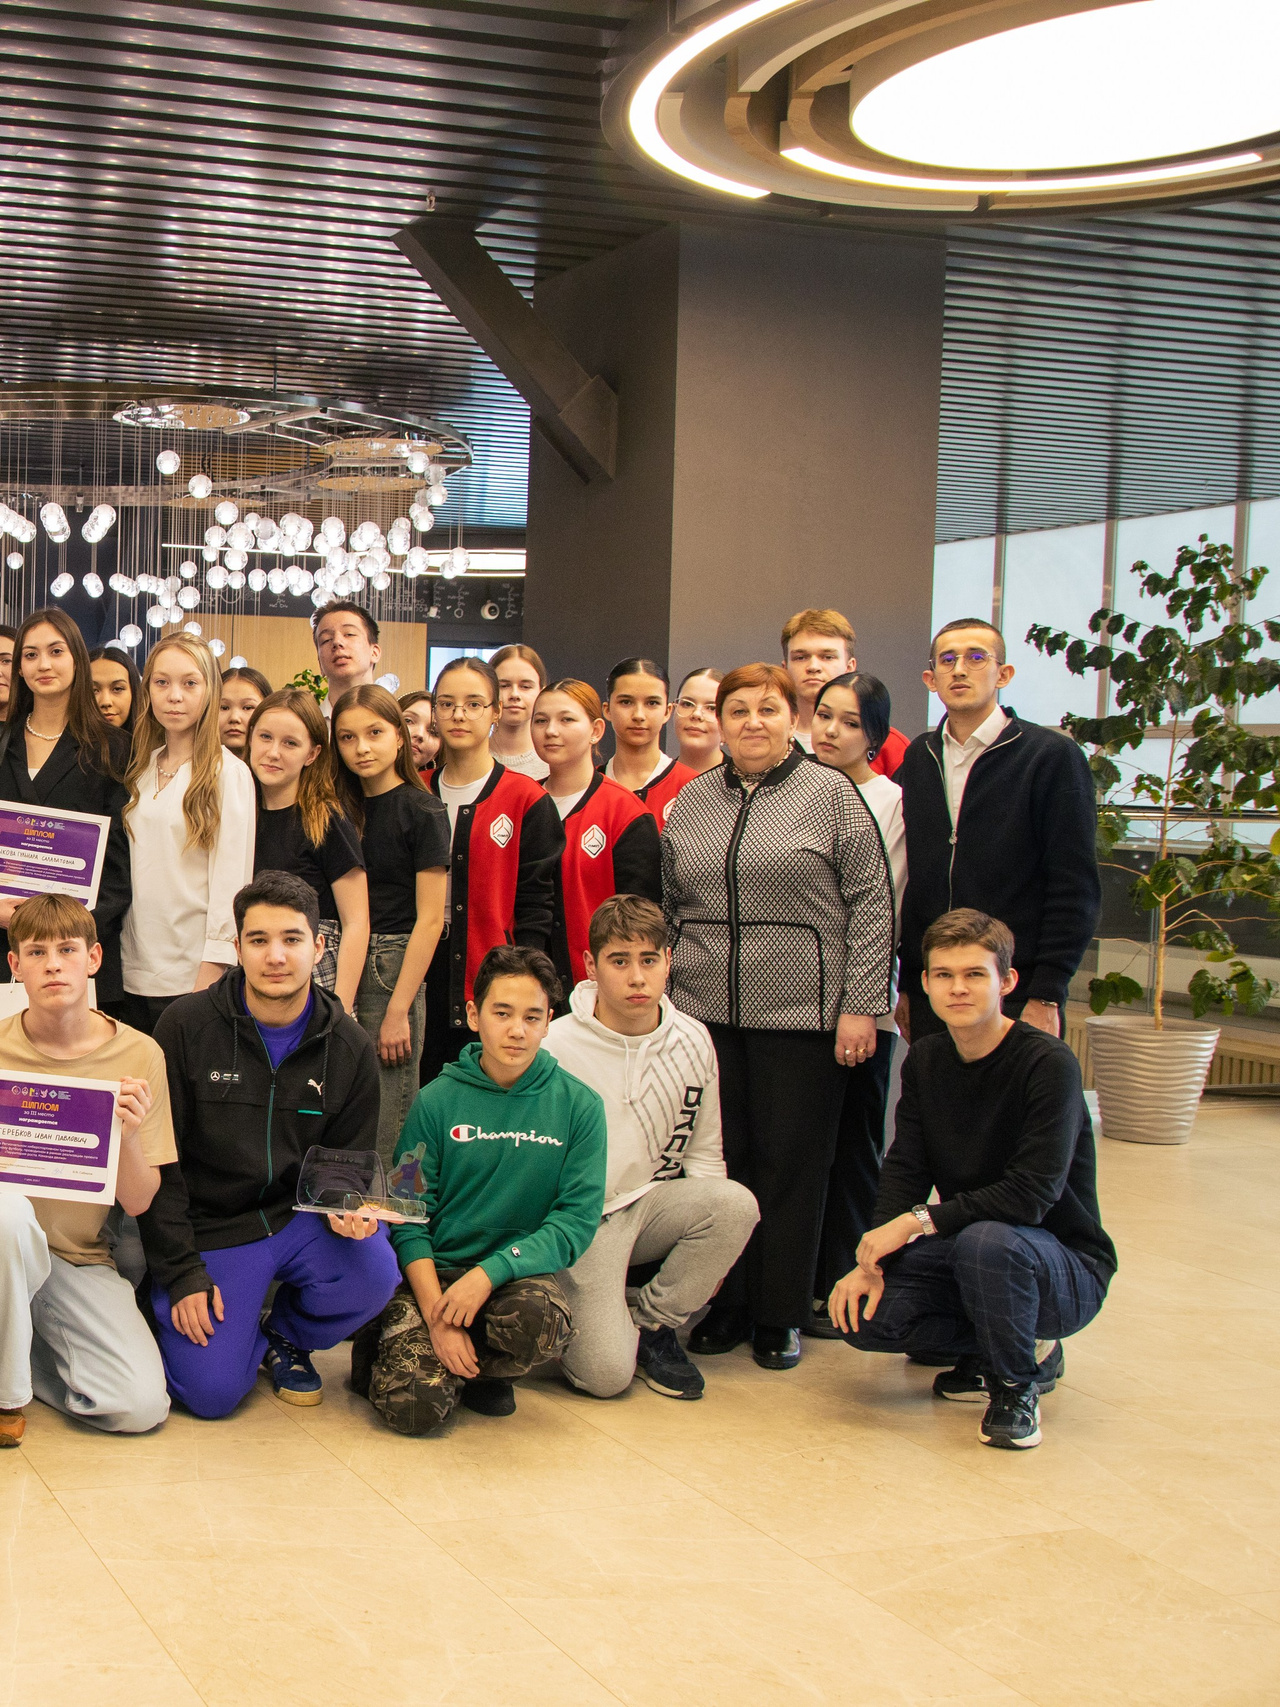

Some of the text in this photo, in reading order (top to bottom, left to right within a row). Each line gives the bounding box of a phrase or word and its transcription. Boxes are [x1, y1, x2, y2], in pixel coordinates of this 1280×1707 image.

[23, 828, 54, 838] ДИПЛОМ
[20, 842, 52, 850] награждается
[20, 1100, 59, 1111] ДИПЛОМ
[18, 1117, 57, 1126] награждается
[34, 1132, 52, 1140] ИВАН
[55, 1134, 87, 1144] ПАВЛОВИЧ
[449, 1124, 563, 1148] Champion
